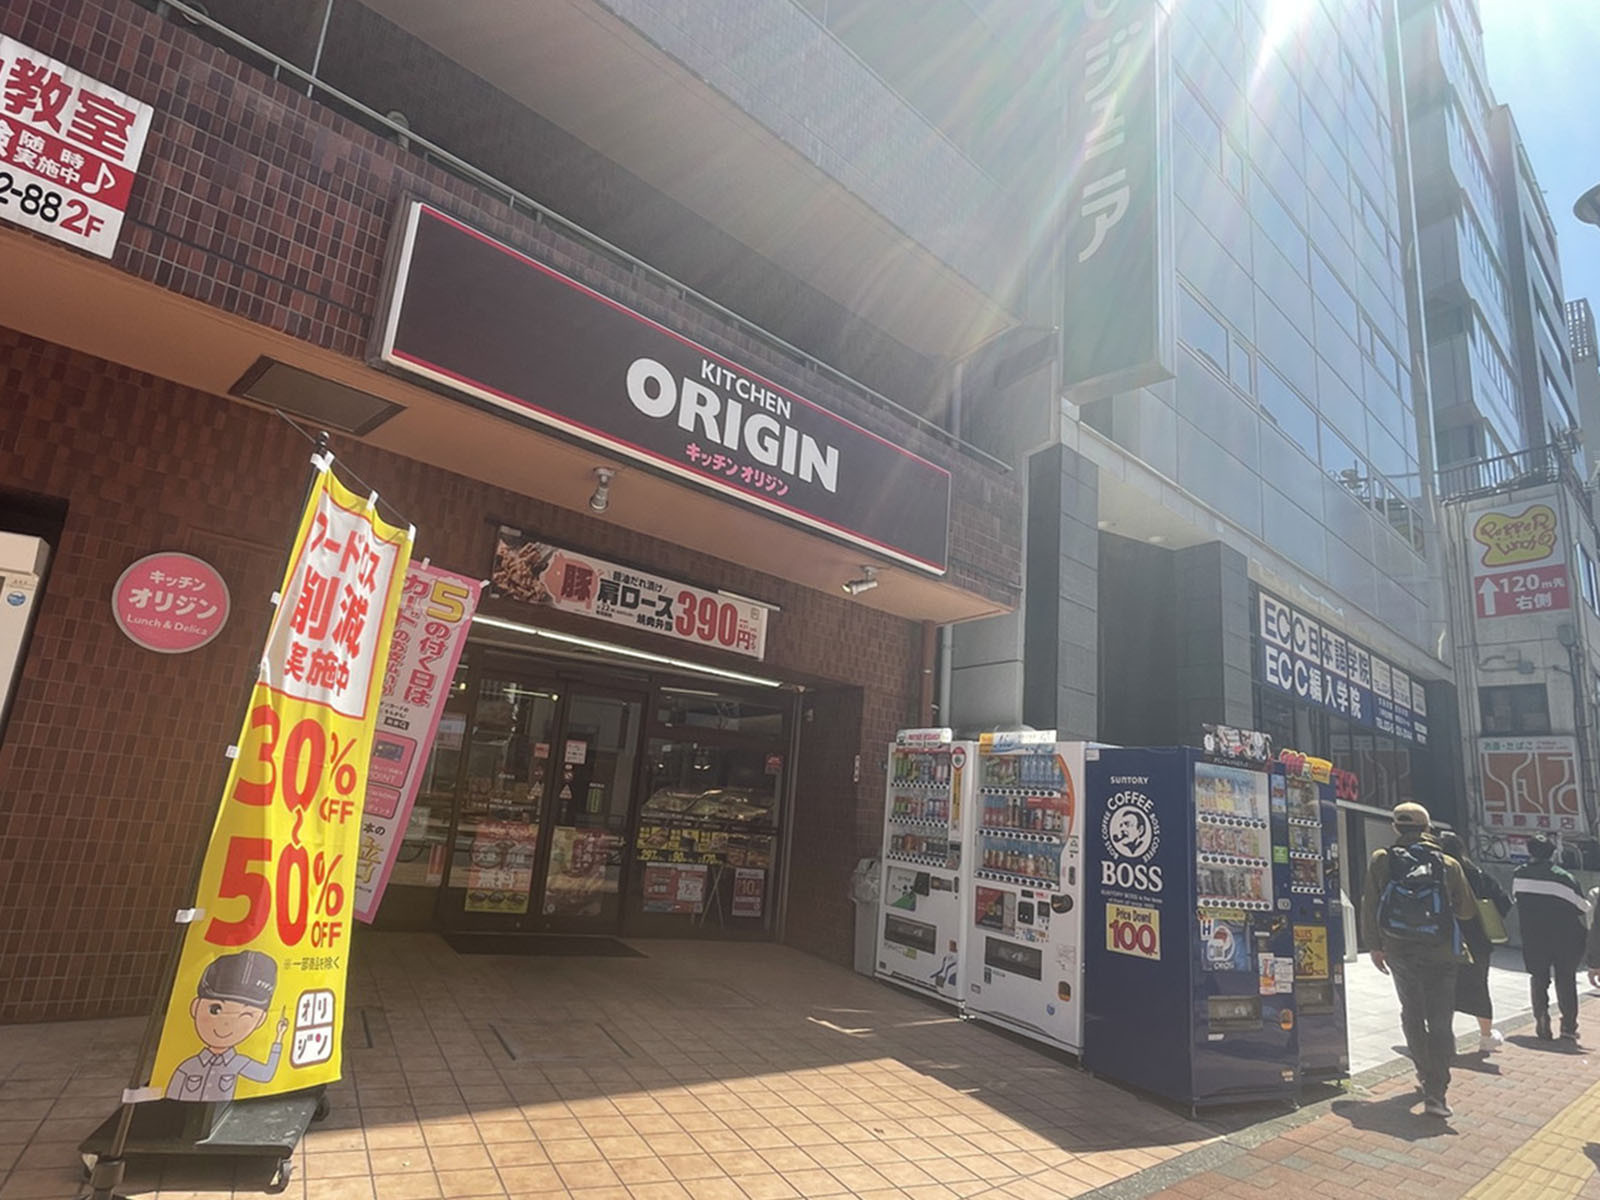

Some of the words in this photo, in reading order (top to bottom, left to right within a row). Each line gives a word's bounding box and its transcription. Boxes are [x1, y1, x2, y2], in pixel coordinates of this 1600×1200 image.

[4, 57, 137, 162] 教室
[13, 146, 80, 185] 実施中
[59, 198, 105, 238] 2F
[701, 358, 792, 420] KITCHEN
[625, 357, 840, 494] ORIGIN
[685, 442, 738, 476] キッチン
[740, 464, 790, 497] オリジン
[149, 570, 207, 592] キッチン
[560, 563, 594, 602] 豚
[597, 578, 675, 621] 肩ロース
[128, 587, 218, 620] オリジン
[288, 565, 369, 660] 削減
[1515, 593, 1553, 610] 右側
[126, 613, 161, 628] Lunch
[163, 619, 172, 630] &
[174, 621, 209, 636] Delica
[283, 641, 350, 697] 実施中
[1107, 790, 1154, 813] COFFEE
[203, 835, 345, 948] 50%
[1100, 860, 1163, 893] BOSS
[310, 921, 343, 948] OFF
